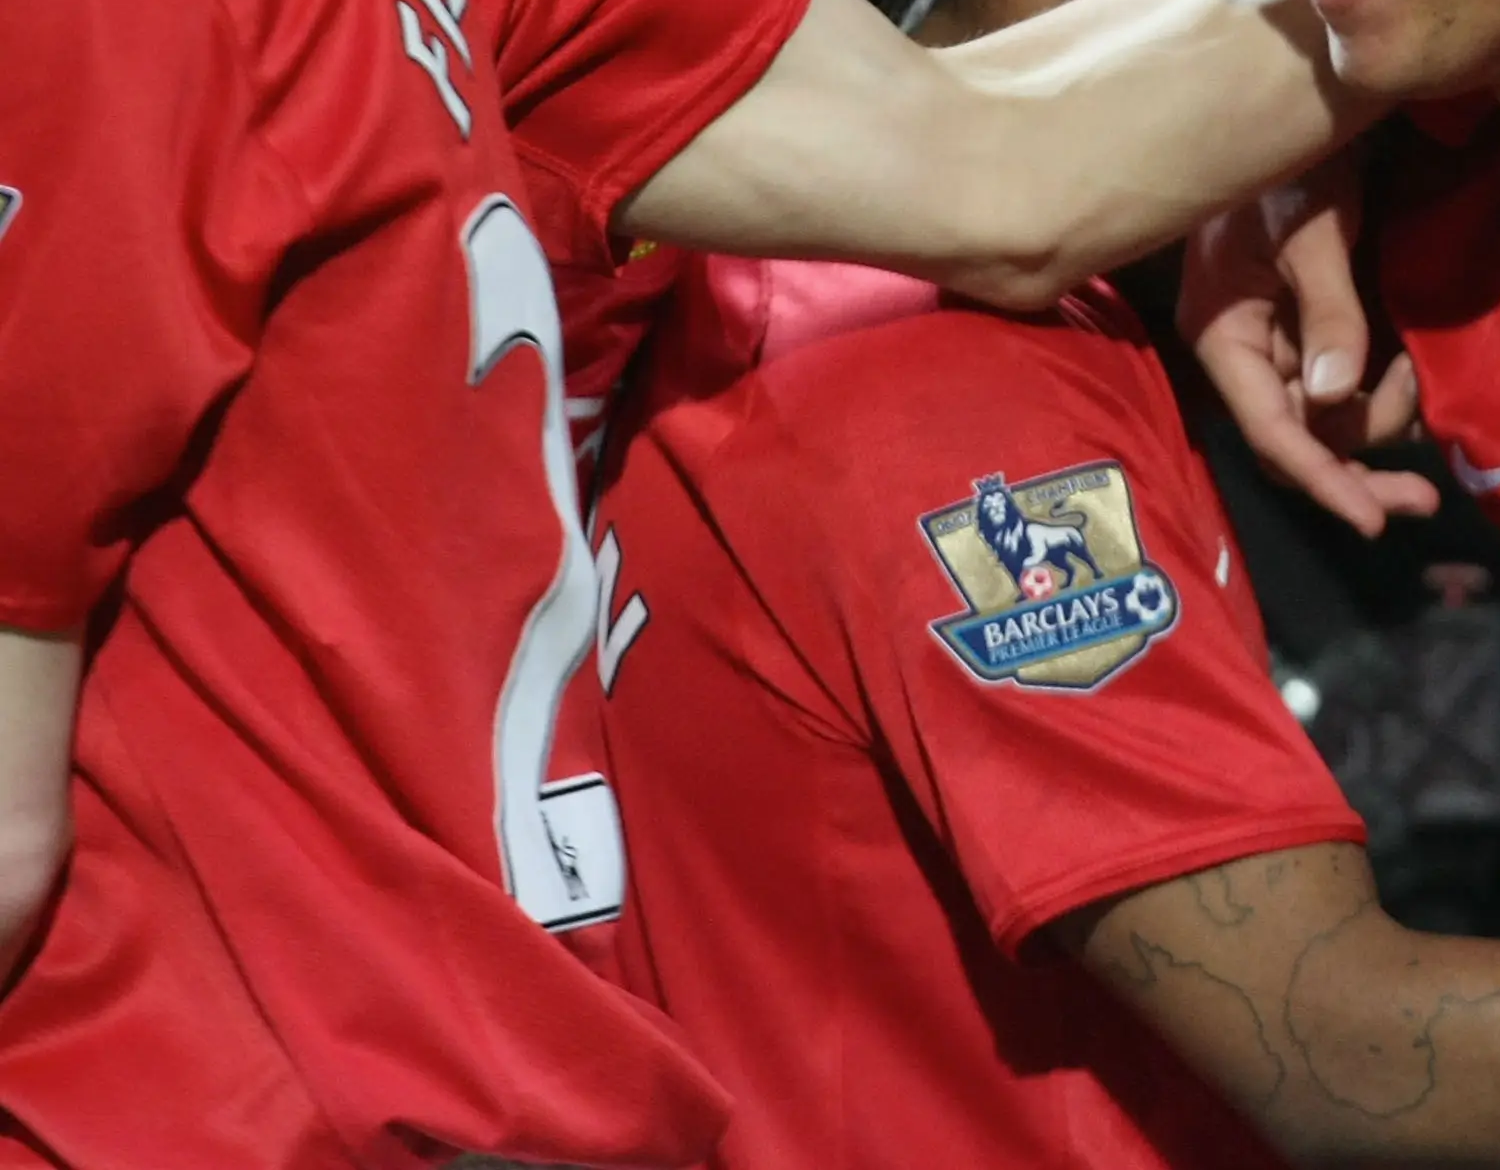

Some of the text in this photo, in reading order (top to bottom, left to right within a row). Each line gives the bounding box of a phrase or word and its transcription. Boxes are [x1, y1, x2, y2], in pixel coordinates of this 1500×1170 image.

[983, 587, 1119, 648] BARCLAYS
[988, 613, 1124, 664] PREMIER LEAGUE
